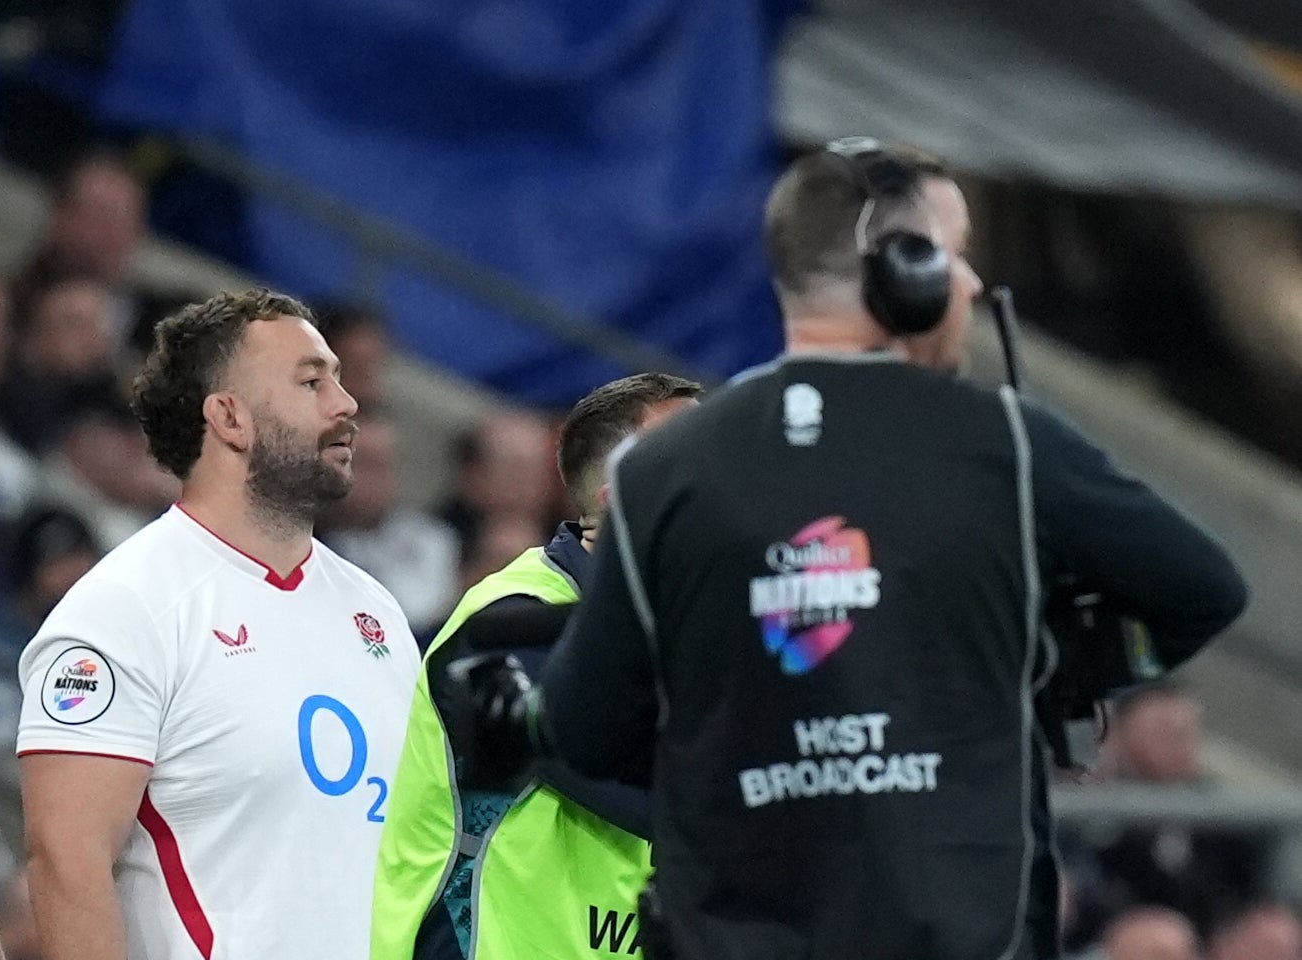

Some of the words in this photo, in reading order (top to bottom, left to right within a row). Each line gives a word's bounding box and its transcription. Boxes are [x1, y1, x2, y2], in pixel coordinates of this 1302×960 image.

[62, 664, 94, 678] Quilter
[54, 678, 98, 692] NATIONS
[739, 752, 942, 808] BROADCAST
